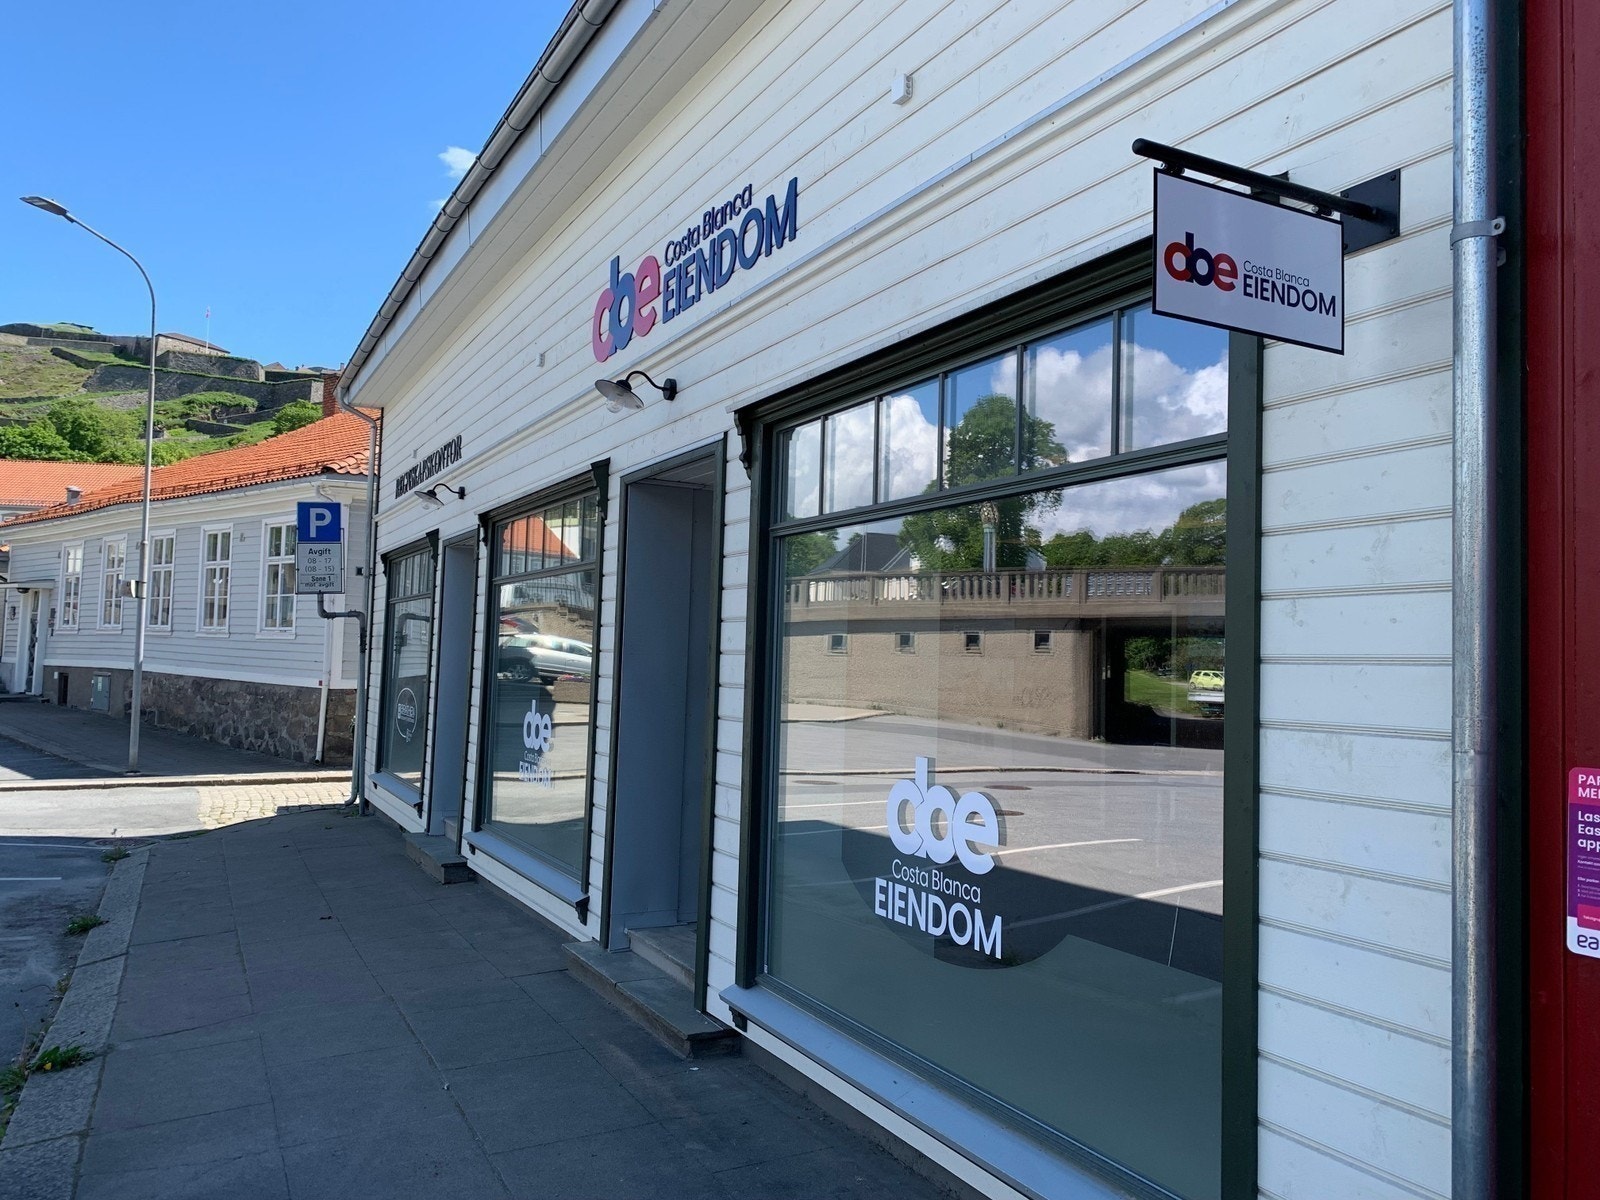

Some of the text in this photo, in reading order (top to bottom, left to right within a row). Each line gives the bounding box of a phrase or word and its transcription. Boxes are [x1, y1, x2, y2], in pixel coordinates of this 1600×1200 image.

[664, 184, 753, 267] Costa Blanca
[662, 177, 798, 324] EIENDOM
[1243, 260, 1310, 287] Costa Blanca
[1243, 273, 1337, 318] EIENDOM
[309, 507, 332, 538] P
[308, 548, 332, 557] Avgift
[892, 858, 982, 903] Costa Blanca
[874, 876, 1002, 960] EIENDOM
